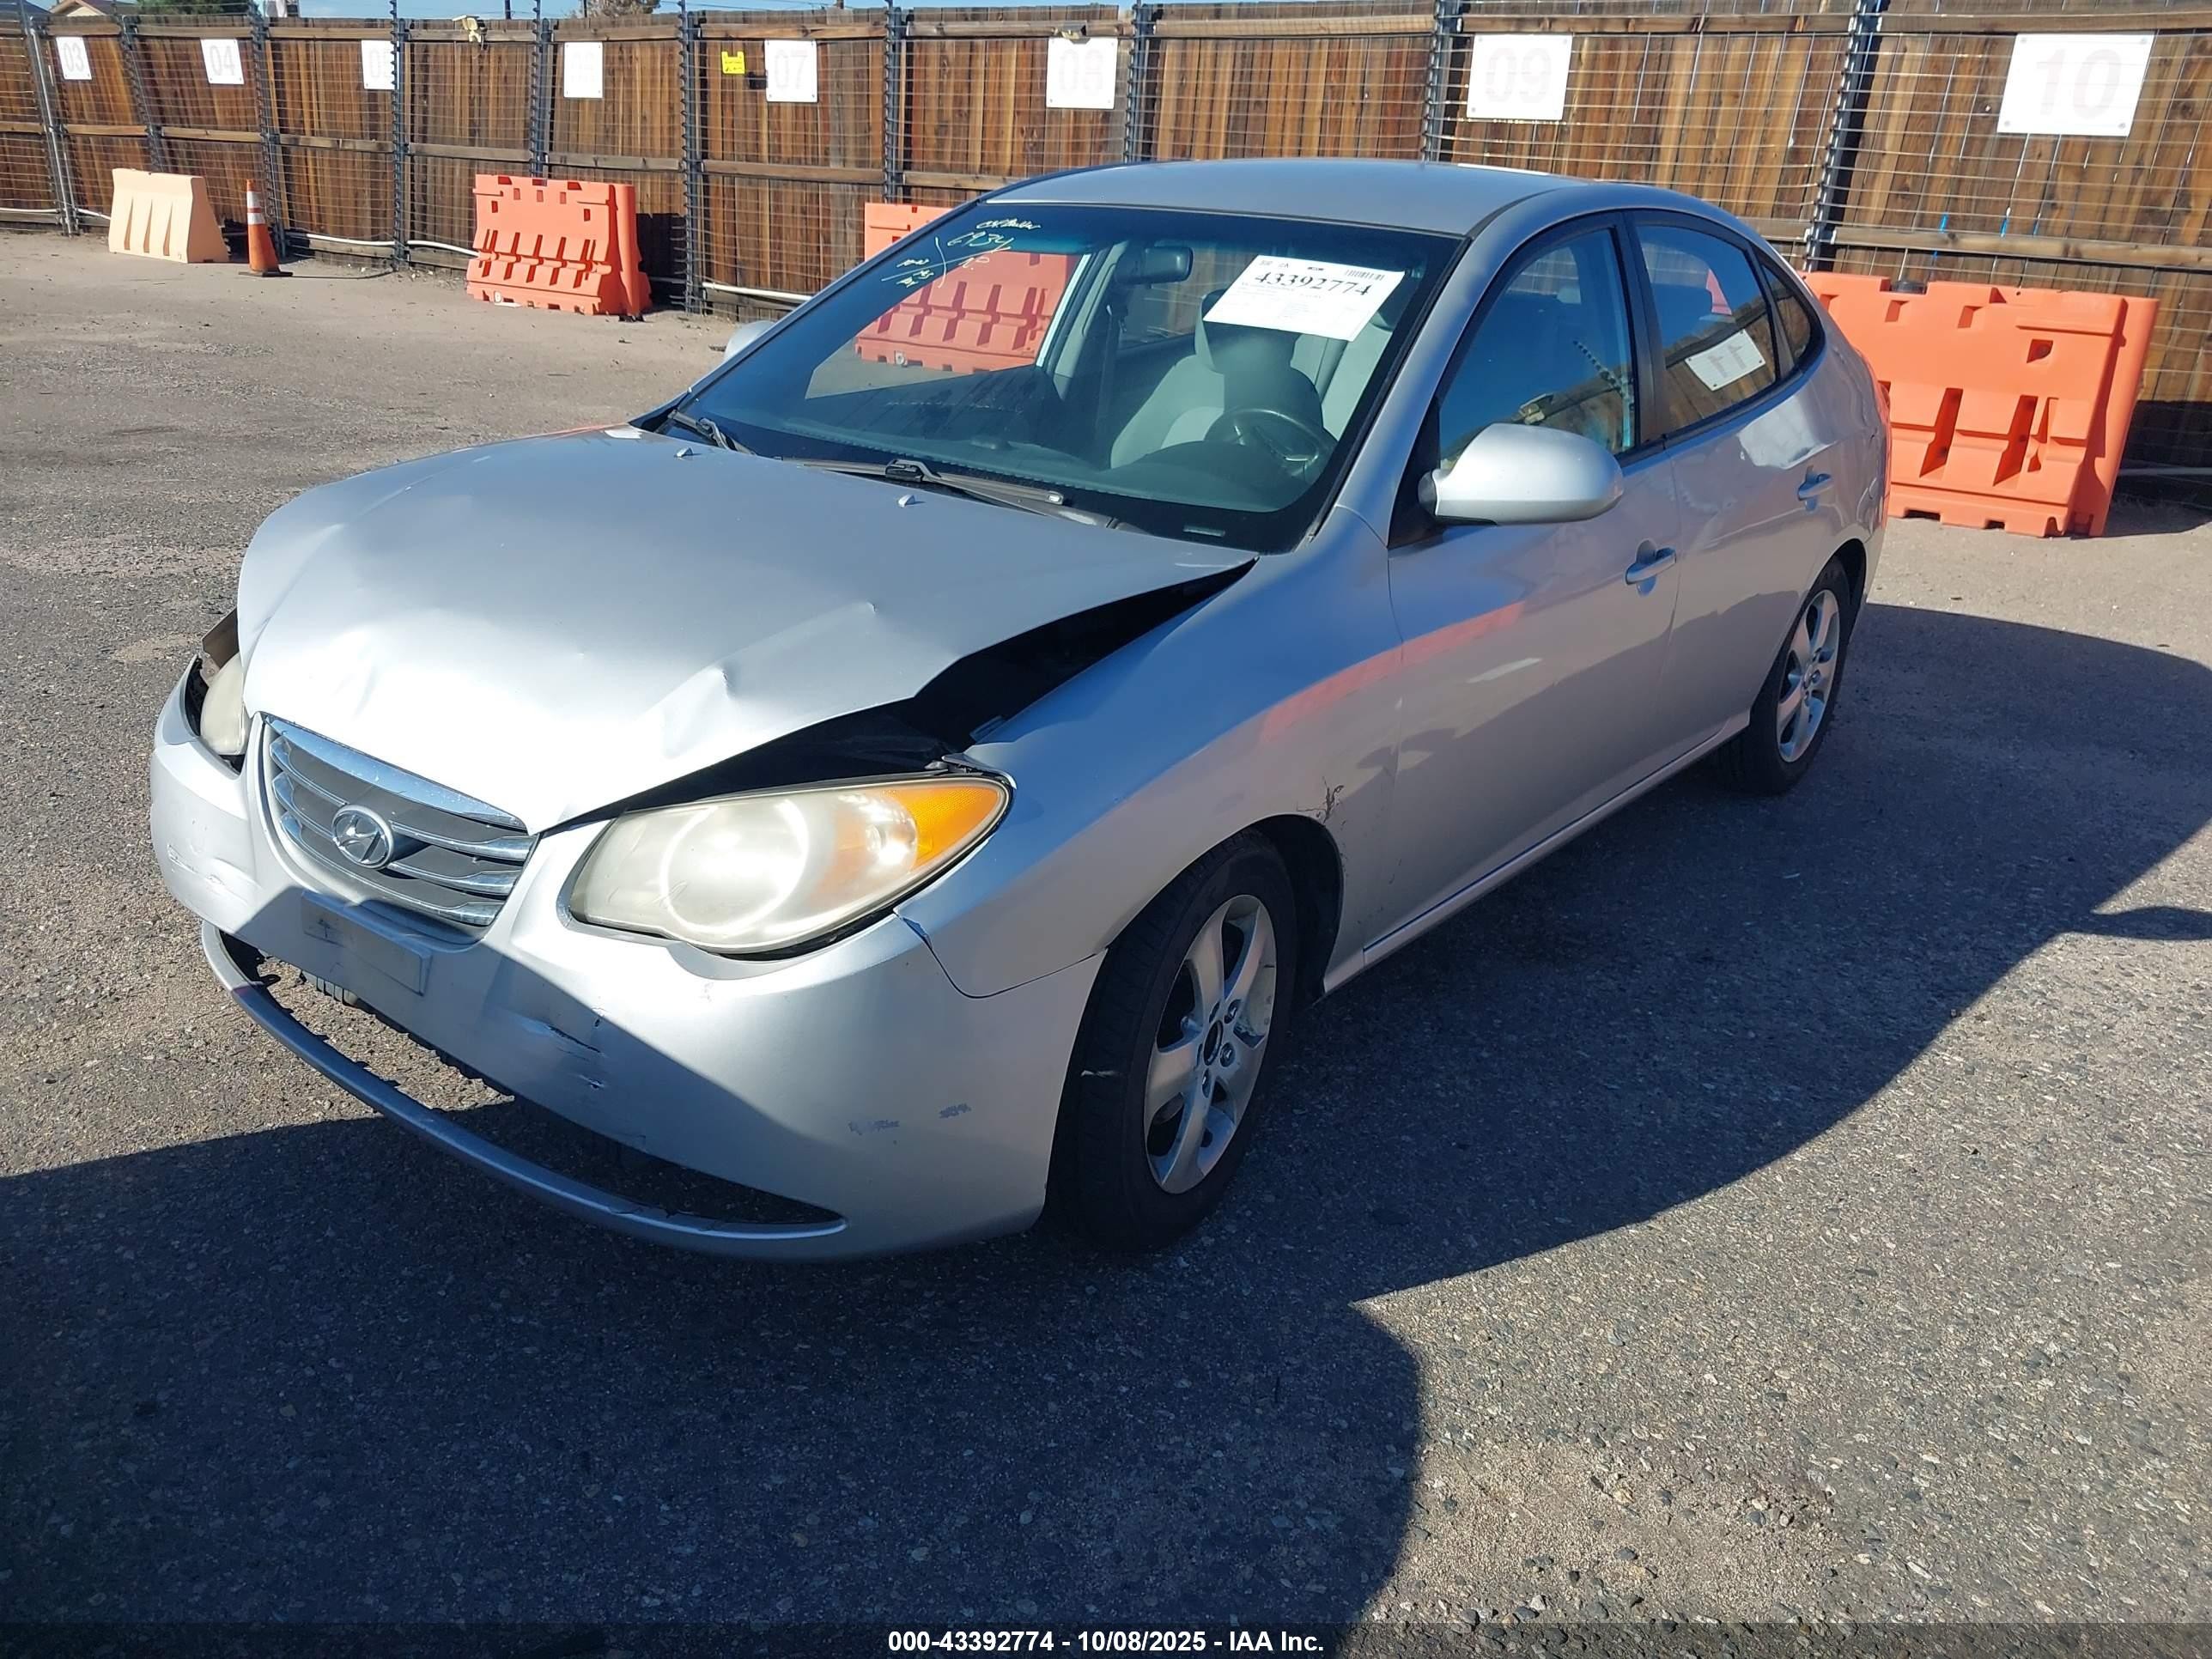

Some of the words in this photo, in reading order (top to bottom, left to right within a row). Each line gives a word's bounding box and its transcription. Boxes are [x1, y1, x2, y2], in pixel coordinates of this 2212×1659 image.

[63, 42, 85, 72] 03
[208, 45, 235, 76] 04
[1484, 47, 1553, 103] 09
[2033, 49, 2122, 118] 10
[1255, 271, 1372, 296] 43392774
